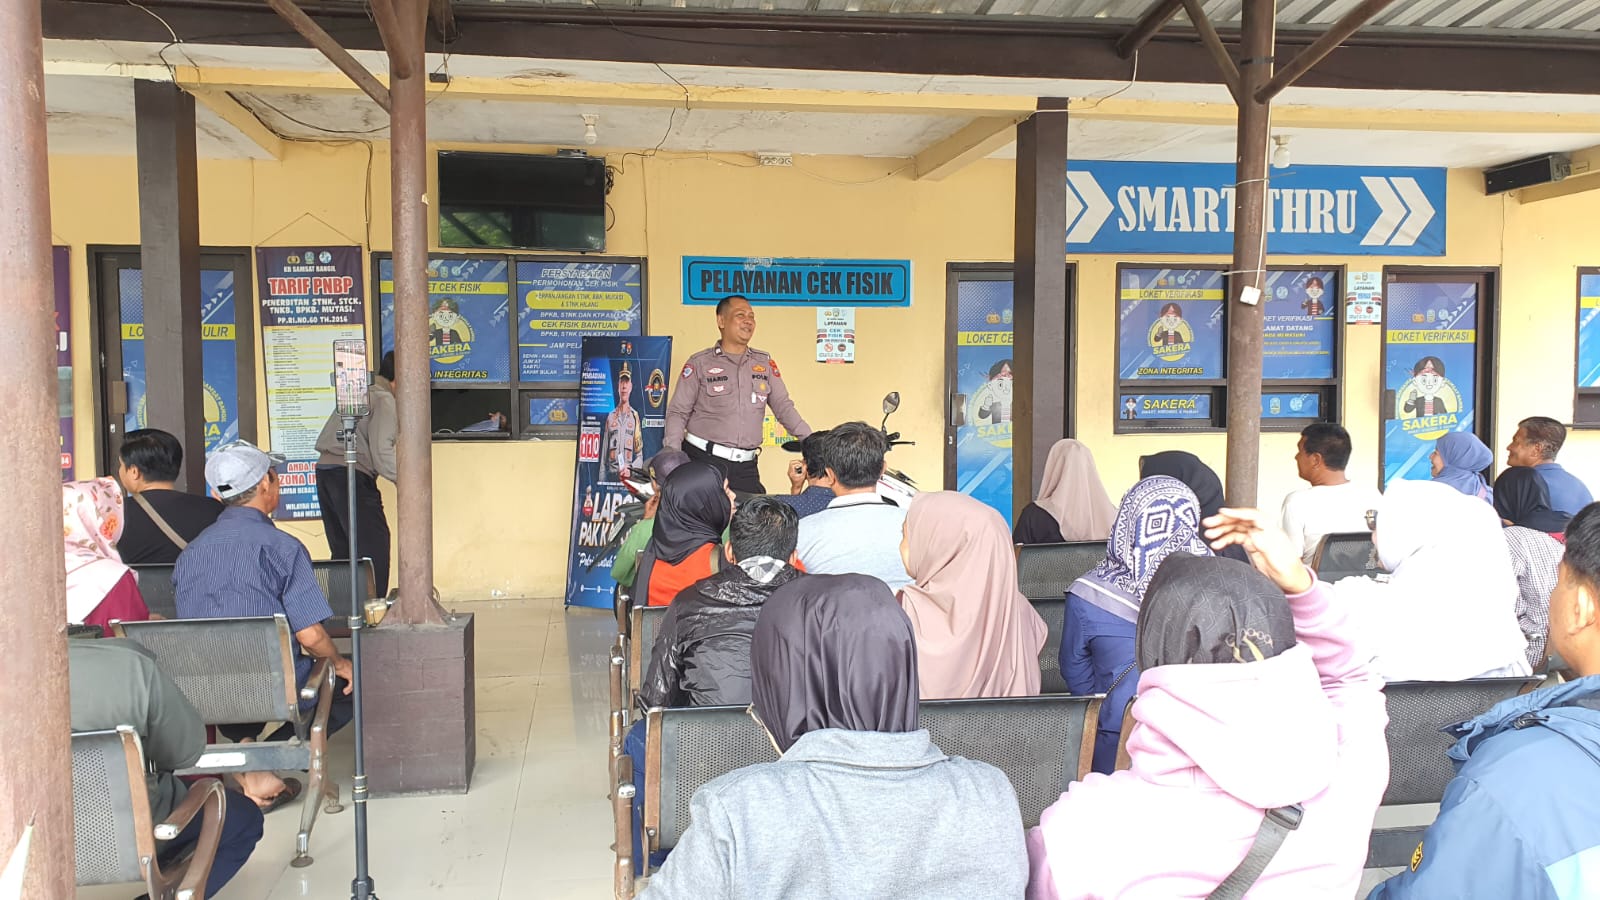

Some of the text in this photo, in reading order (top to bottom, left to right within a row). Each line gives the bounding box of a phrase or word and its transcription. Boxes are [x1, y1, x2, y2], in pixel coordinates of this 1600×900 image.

[1117, 186, 1237, 233] SMART
[268, 276, 353, 295] TARIF PNBP
[439, 283, 457, 292] CEK
[460, 283, 481, 292] FISIK
[701, 270, 893, 295] PELAYANAN CEK FISIK
[1140, 290, 1203, 298] LOKET VERIFIKASI
[262, 299, 310, 307] PENERBITAN
[202, 326, 229, 337] ULIR
[1392, 331, 1469, 341] LOKET VERIFIKASI
[966, 333, 1013, 344] LOKET CE
[1153, 342, 1191, 355] SAKERA
[434, 371, 488, 379] INTEGRITAS
[1137, 367, 1203, 375] ZONA INTEGRITAS
[1143, 399, 1196, 409] SAKERA
[1402, 413, 1458, 431] SAKERA
[278, 473, 307, 487] ZONA
